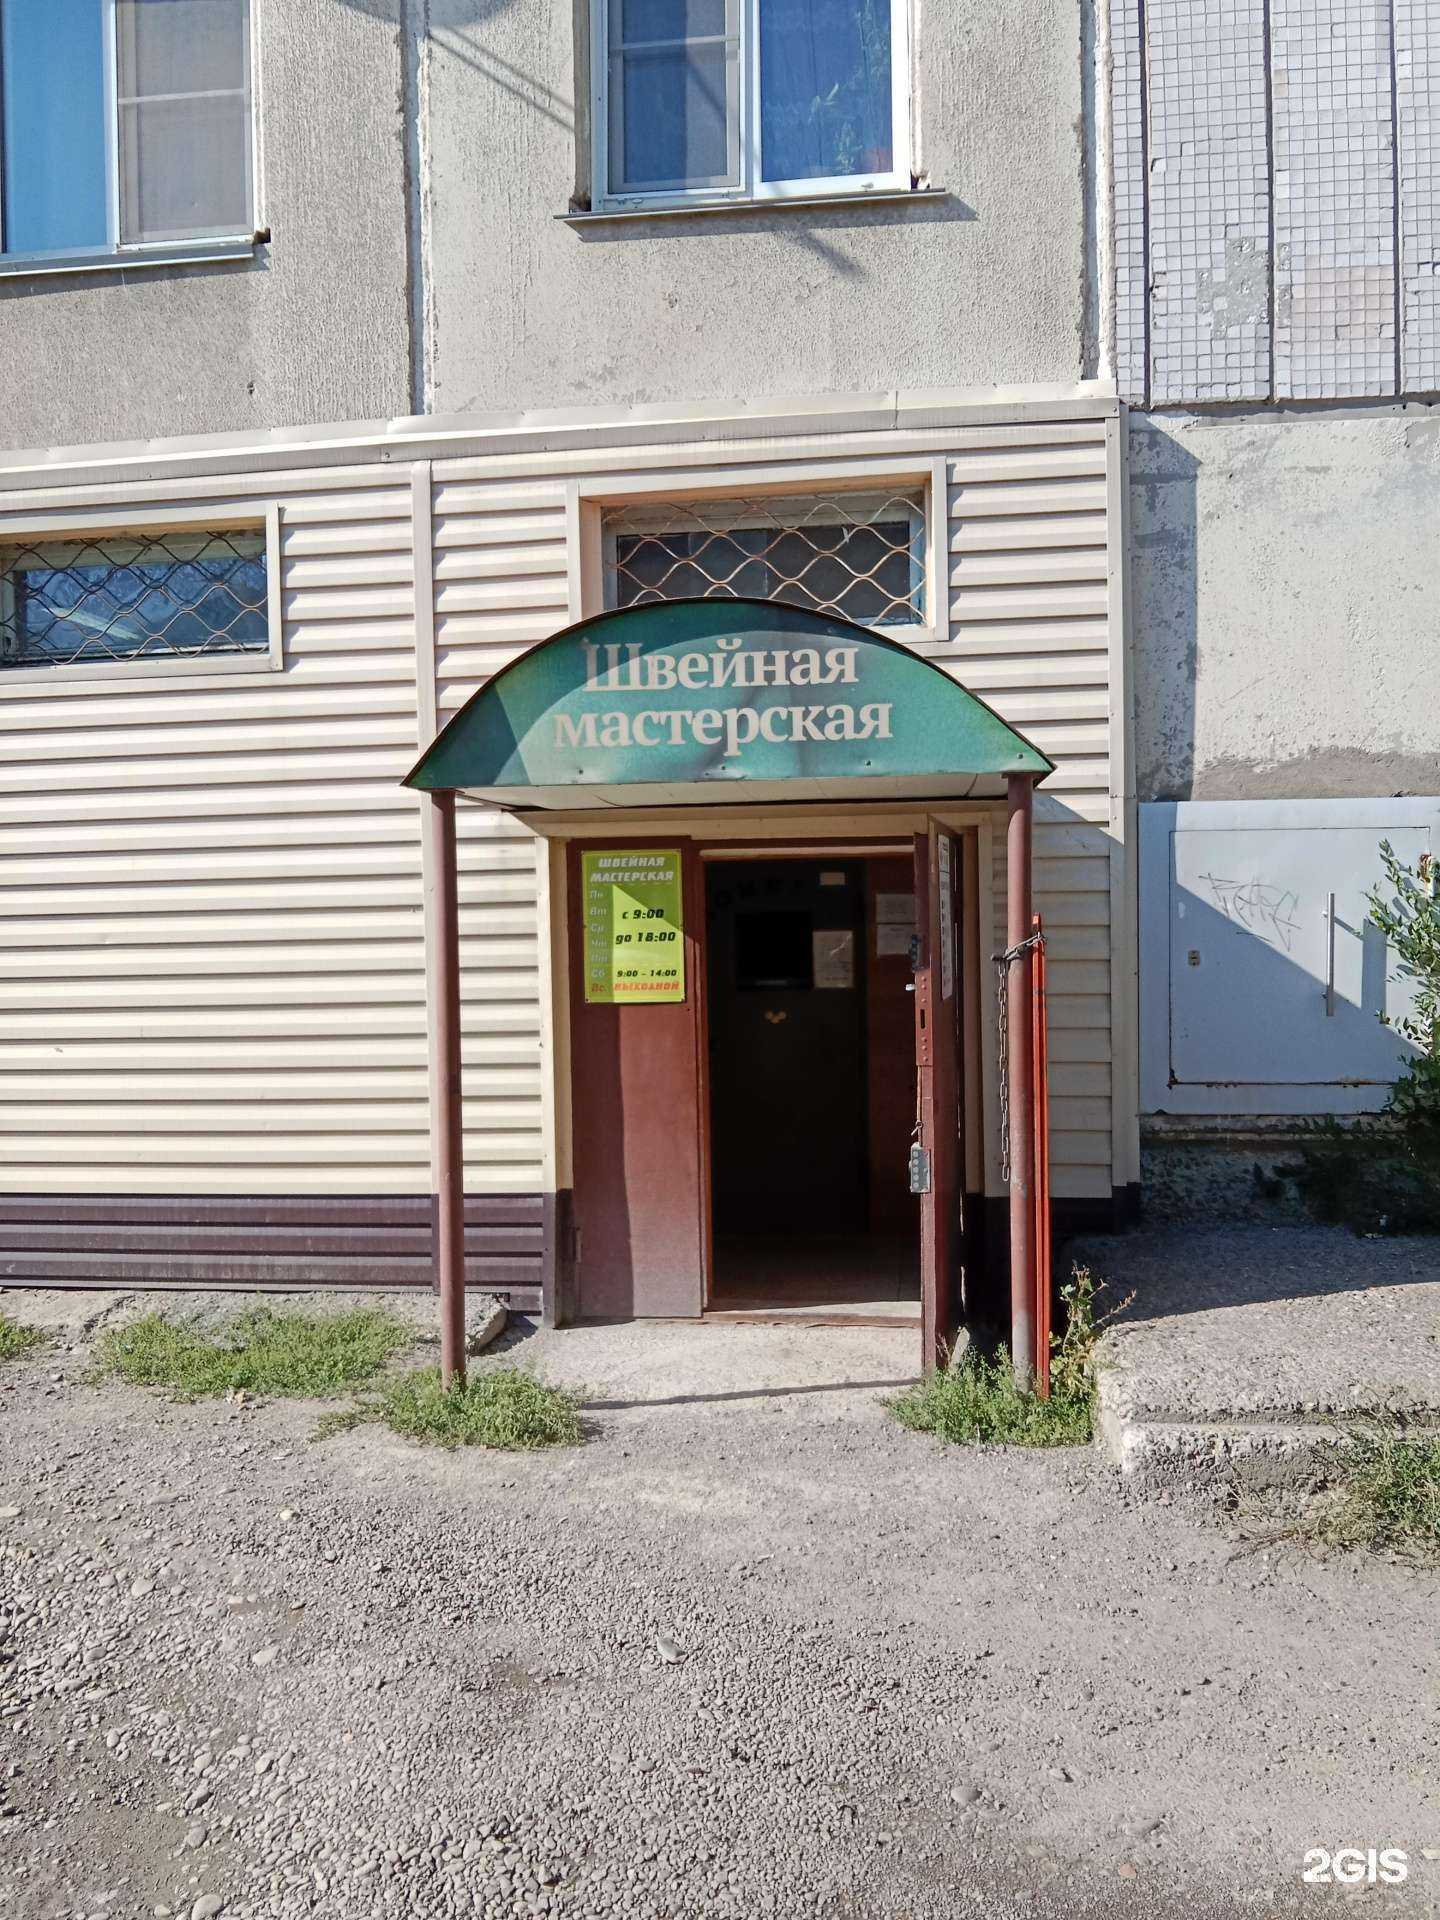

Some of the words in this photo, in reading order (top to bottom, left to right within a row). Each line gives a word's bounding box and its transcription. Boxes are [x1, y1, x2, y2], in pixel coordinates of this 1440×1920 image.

[582, 638, 859, 693] Швейная
[553, 703, 893, 757] мастерская
[598, 855, 666, 868] ШВЕЙНАЯ
[590, 871, 674, 883] МАСТЕРСКАЯ
[633, 908, 665, 920] 9:00
[615, 934, 632, 945] до
[637, 932, 676, 943] 18:00
[617, 970, 639, 978] 9:00
[650, 969, 677, 977] 14:00
[614, 981, 680, 992] ВЫХОДНОЙ
